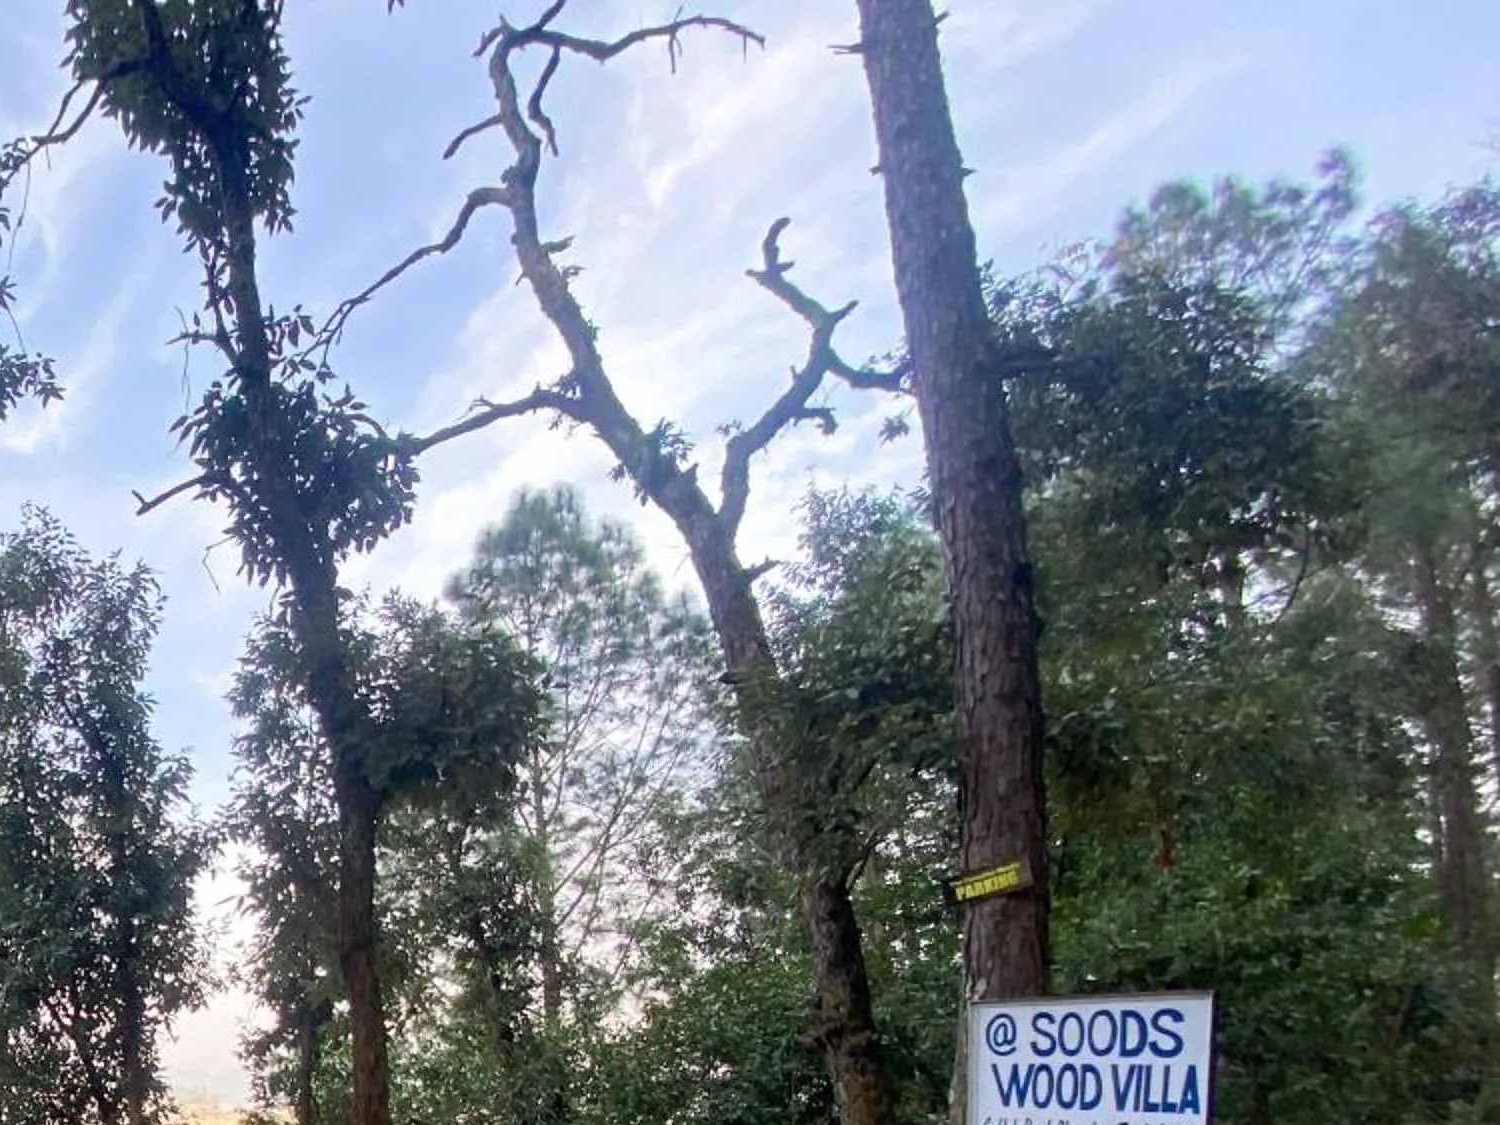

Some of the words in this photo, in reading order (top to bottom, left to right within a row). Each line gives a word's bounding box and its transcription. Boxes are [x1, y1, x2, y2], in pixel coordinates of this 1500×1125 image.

[955, 869, 1020, 901] PARKING
[985, 1013, 1017, 1057] @
[1030, 1008, 1185, 1059] SOODS
[991, 1063, 1102, 1110] WOOD
[1111, 1063, 1200, 1114] VILLA
